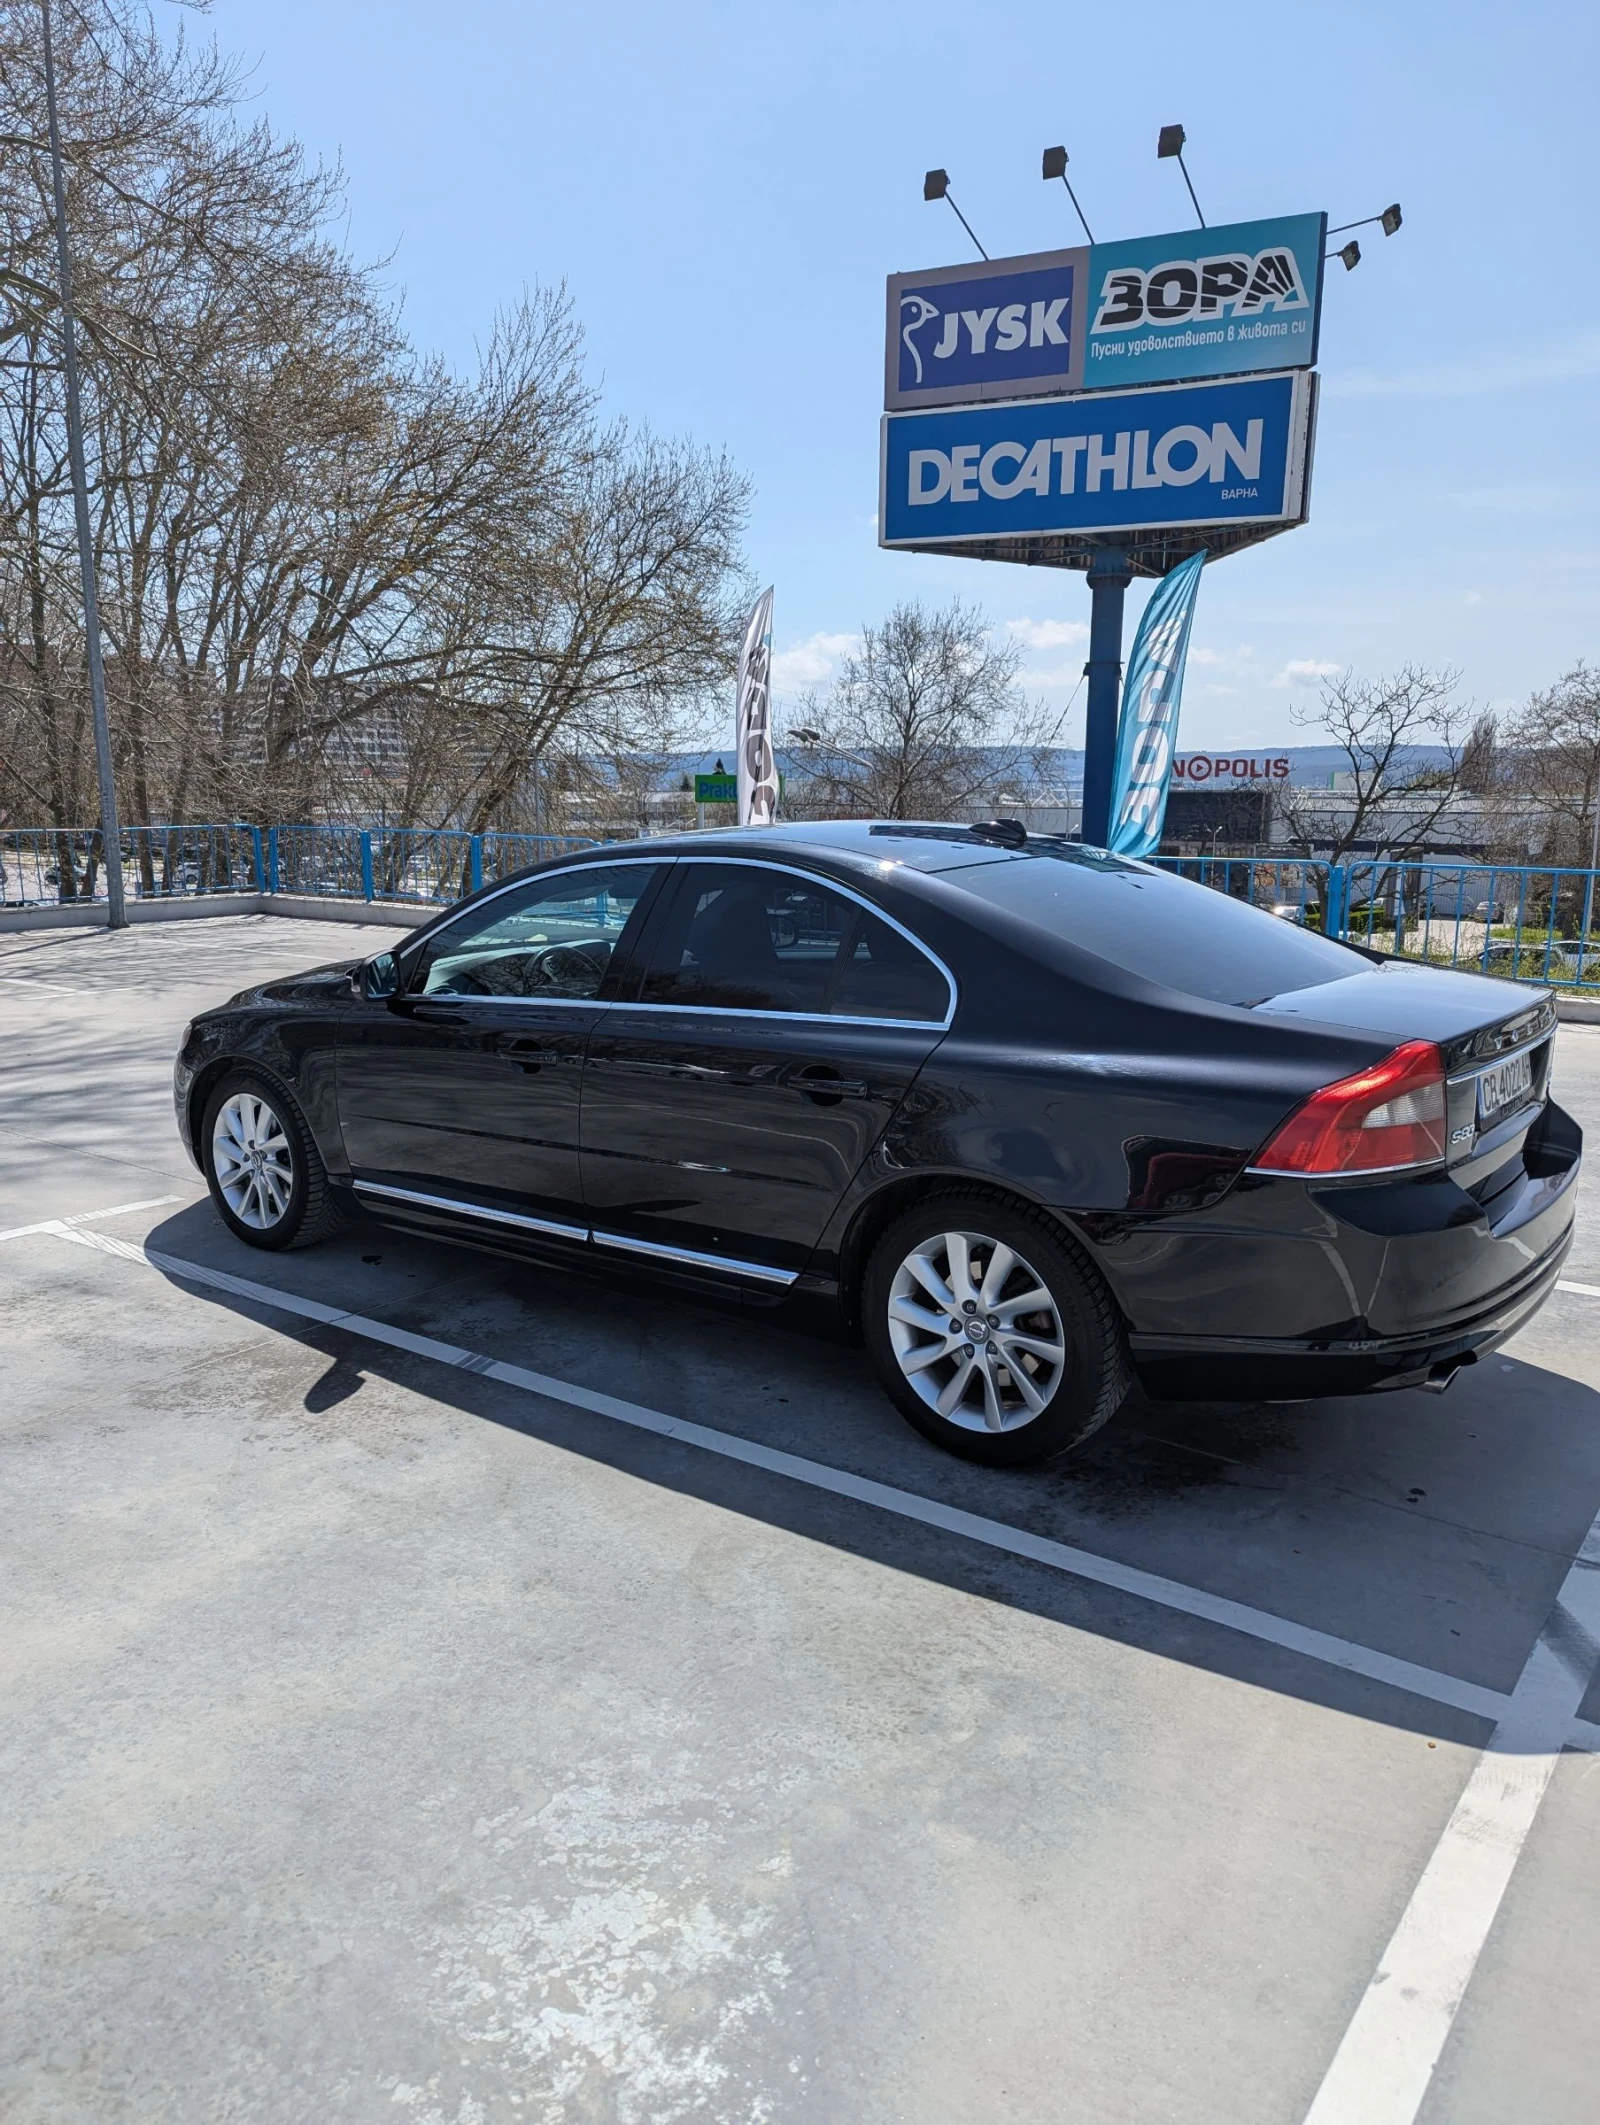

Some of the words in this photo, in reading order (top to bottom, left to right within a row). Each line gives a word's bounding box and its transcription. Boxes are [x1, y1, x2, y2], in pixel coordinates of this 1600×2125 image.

[1091, 247, 1309, 334] ЗОРА
[933, 297, 1070, 359] JYSK
[1091, 341, 1125, 360] Пусни
[1127, 331, 1224, 357] удоволствието
[1227, 325, 1235, 342] в
[1237, 321, 1288, 341] живота
[1291, 320, 1306, 334] си
[908, 418, 1264, 506] DECATHLON
[1221, 487, 1259, 500] ВАРНА
[1172, 755, 1290, 781] NOPOLIS
[1483, 1073, 1500, 1112] CB
[1500, 1059, 1522, 1102] 4022
